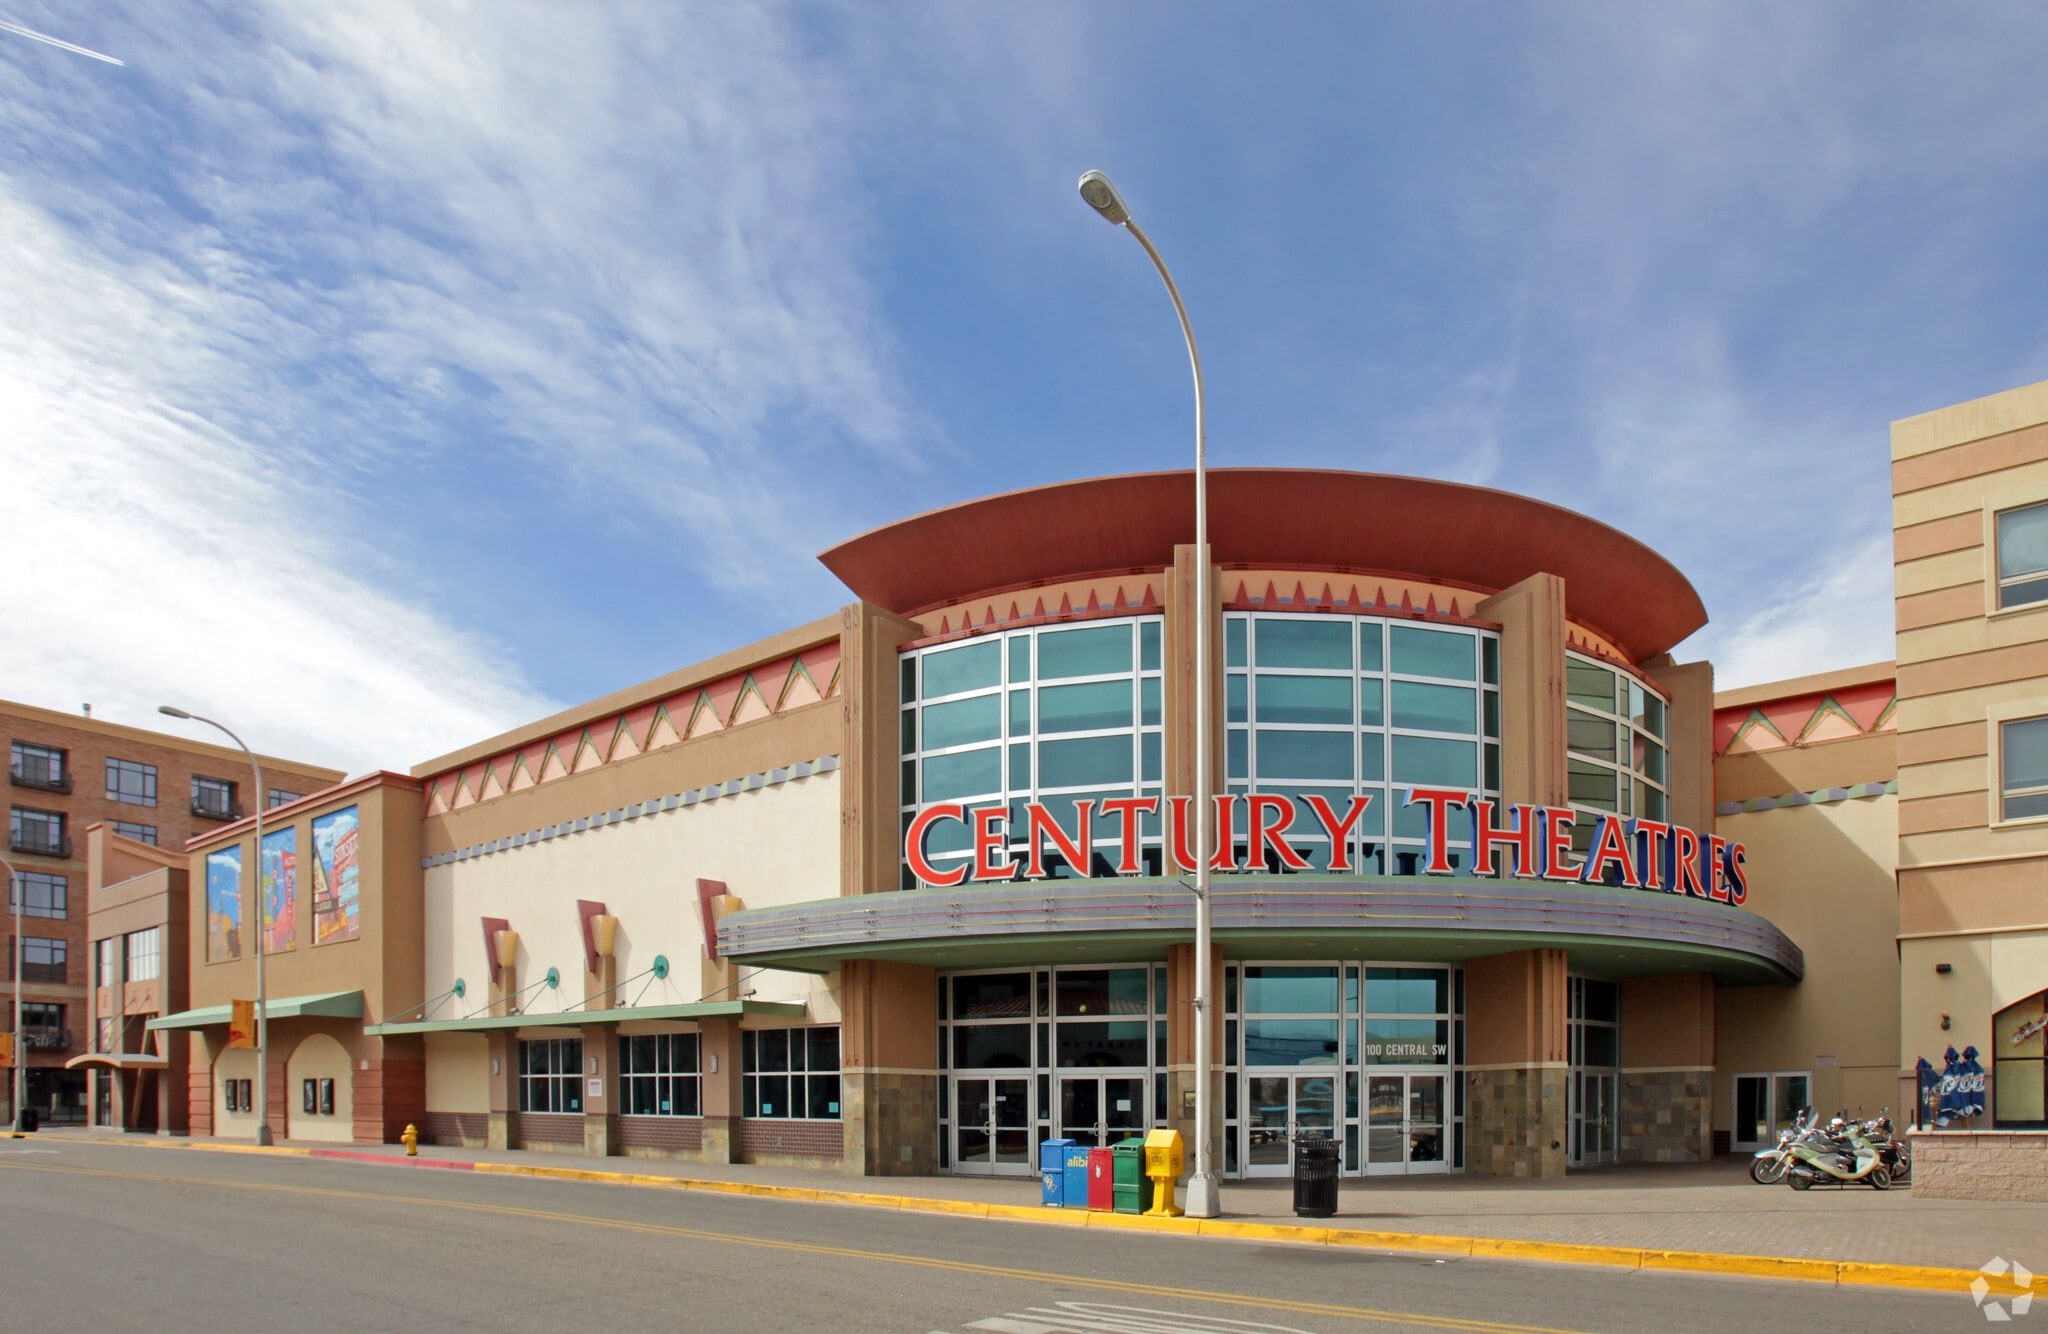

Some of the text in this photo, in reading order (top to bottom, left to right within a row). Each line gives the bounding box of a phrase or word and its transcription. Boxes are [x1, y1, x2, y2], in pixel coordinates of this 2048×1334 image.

[904, 787, 1748, 907] CENTURY THEATRES
[1366, 1044, 1446, 1055] 100 CENTRAL SW
